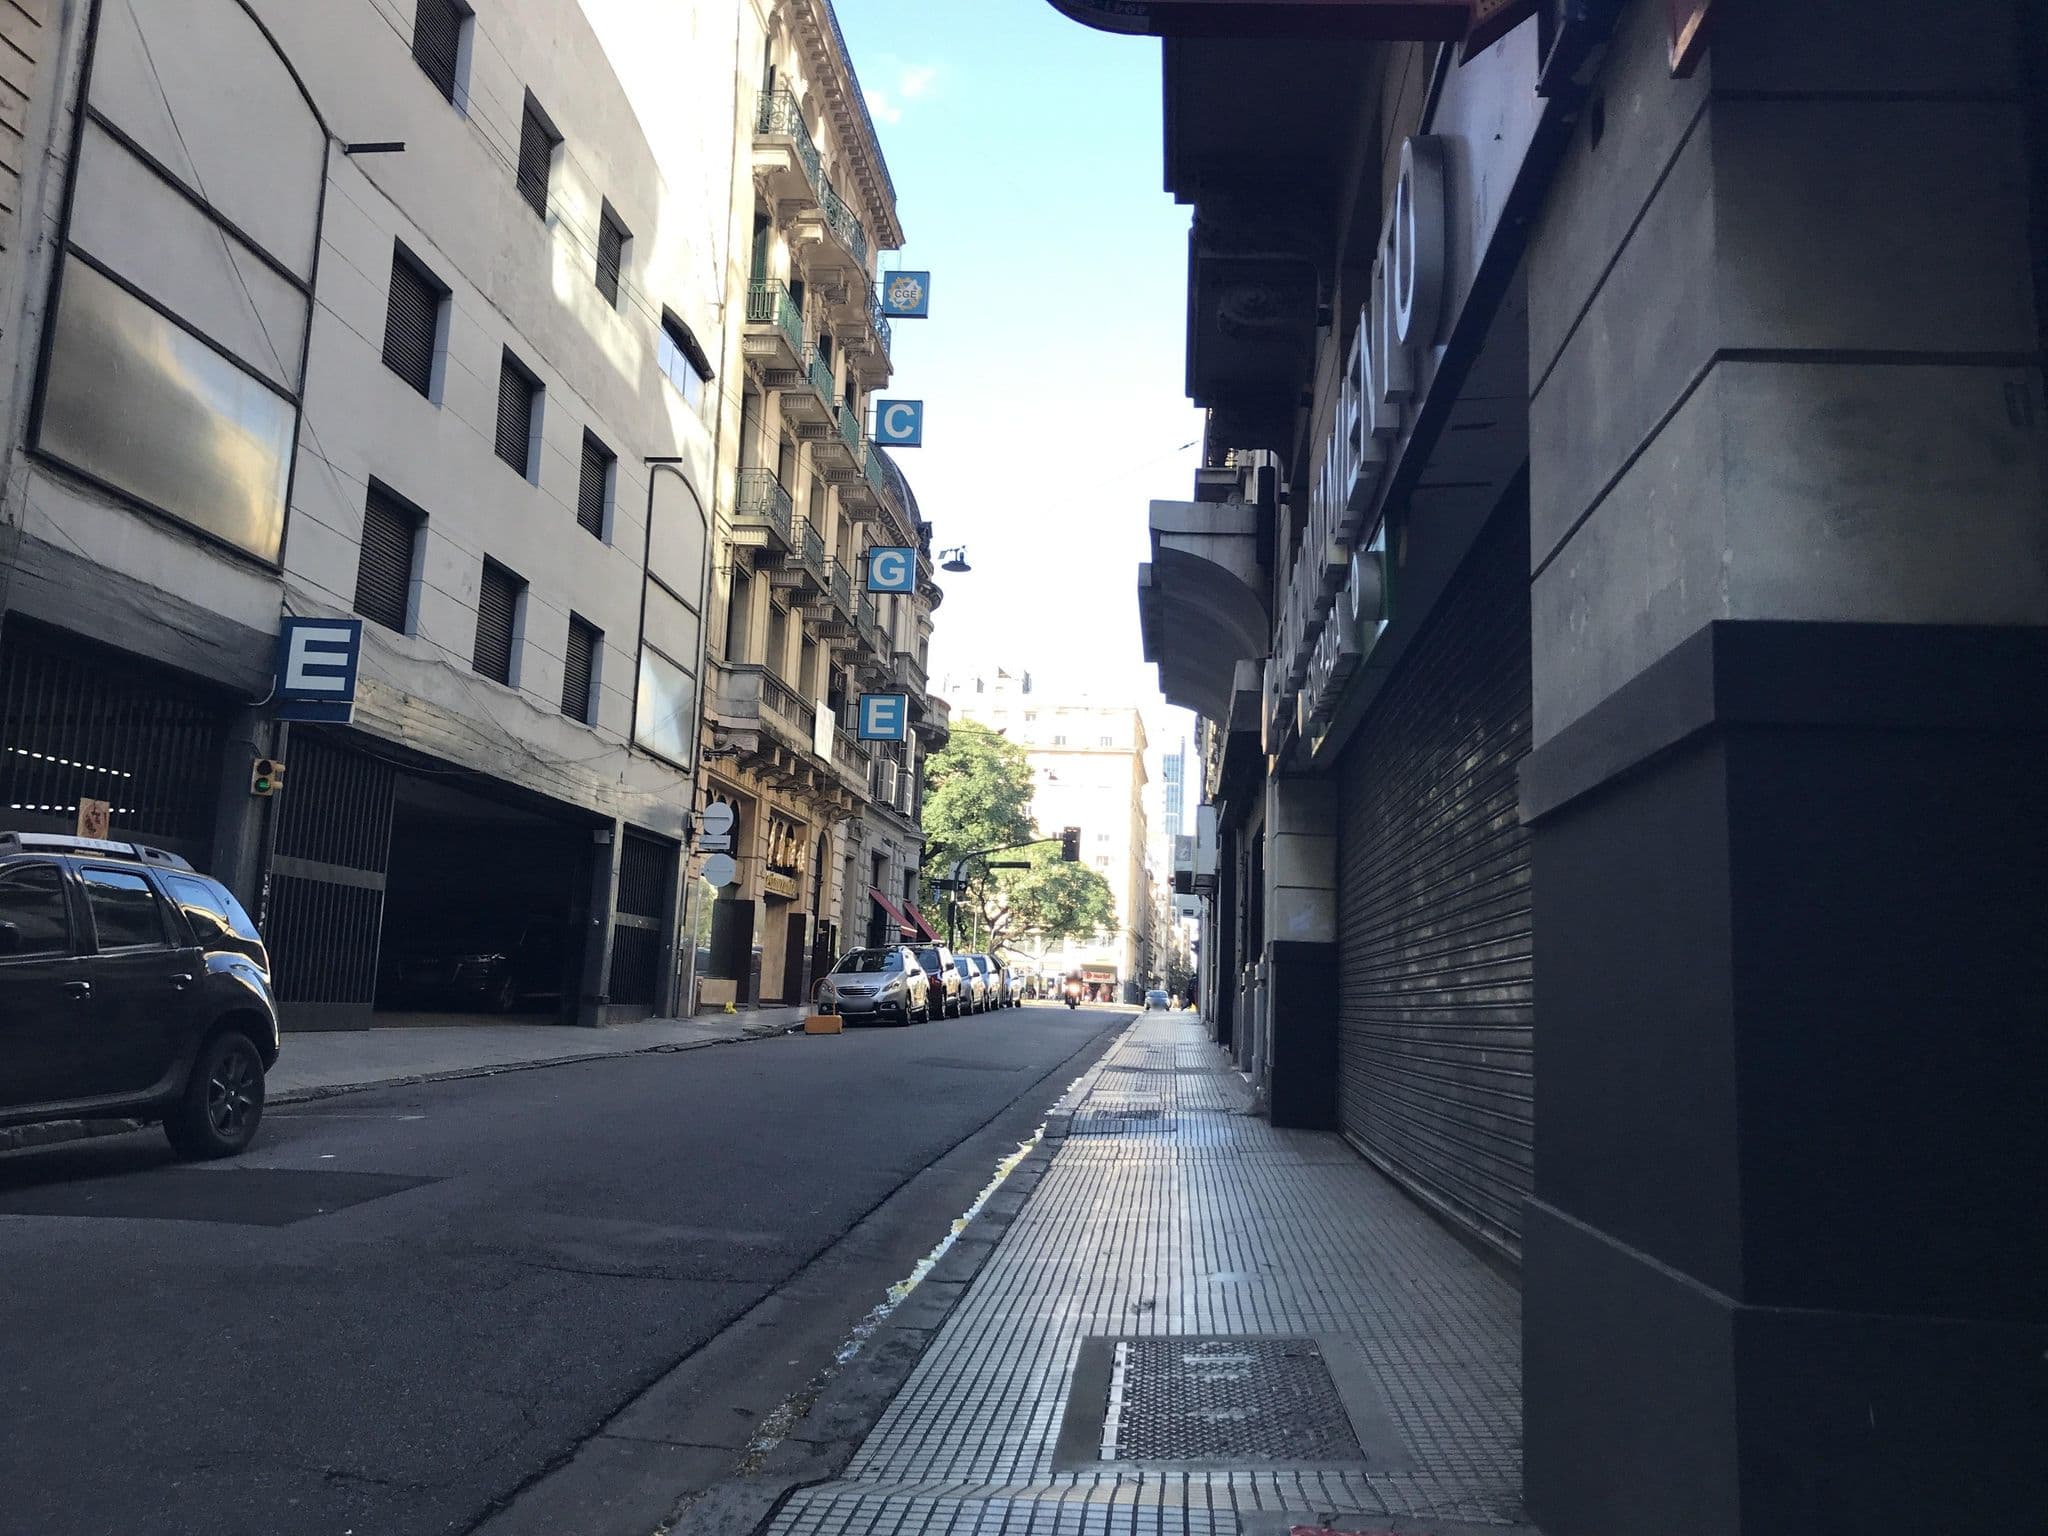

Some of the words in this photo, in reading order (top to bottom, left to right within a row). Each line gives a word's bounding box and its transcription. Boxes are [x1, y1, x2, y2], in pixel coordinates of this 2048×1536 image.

[894, 289, 917, 300] CGE
[884, 403, 915, 439] C
[872, 551, 906, 587] G
[285, 626, 352, 691] E
[867, 698, 896, 735] E
